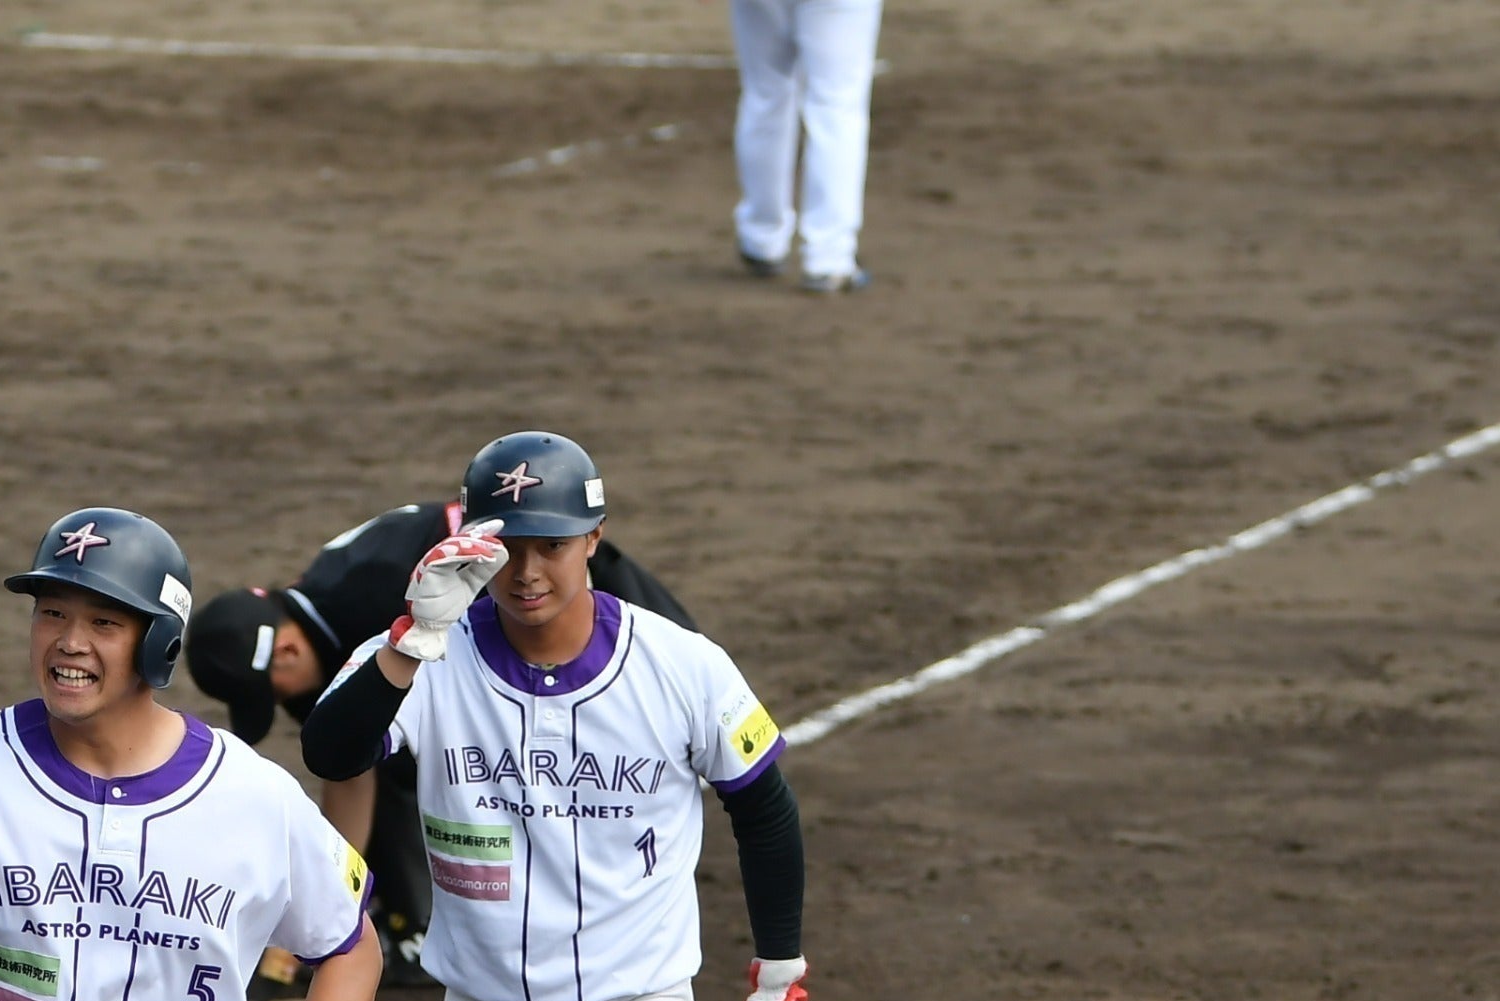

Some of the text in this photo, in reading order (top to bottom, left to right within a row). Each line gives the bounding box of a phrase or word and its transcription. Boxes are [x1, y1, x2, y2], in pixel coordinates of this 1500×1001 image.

[444, 745, 667, 795] IBARAKI
[474, 795, 635, 820] ASTRO PLANETS
[633, 825, 658, 880] 1
[21, 919, 202, 951] ASTRO PLANETS
